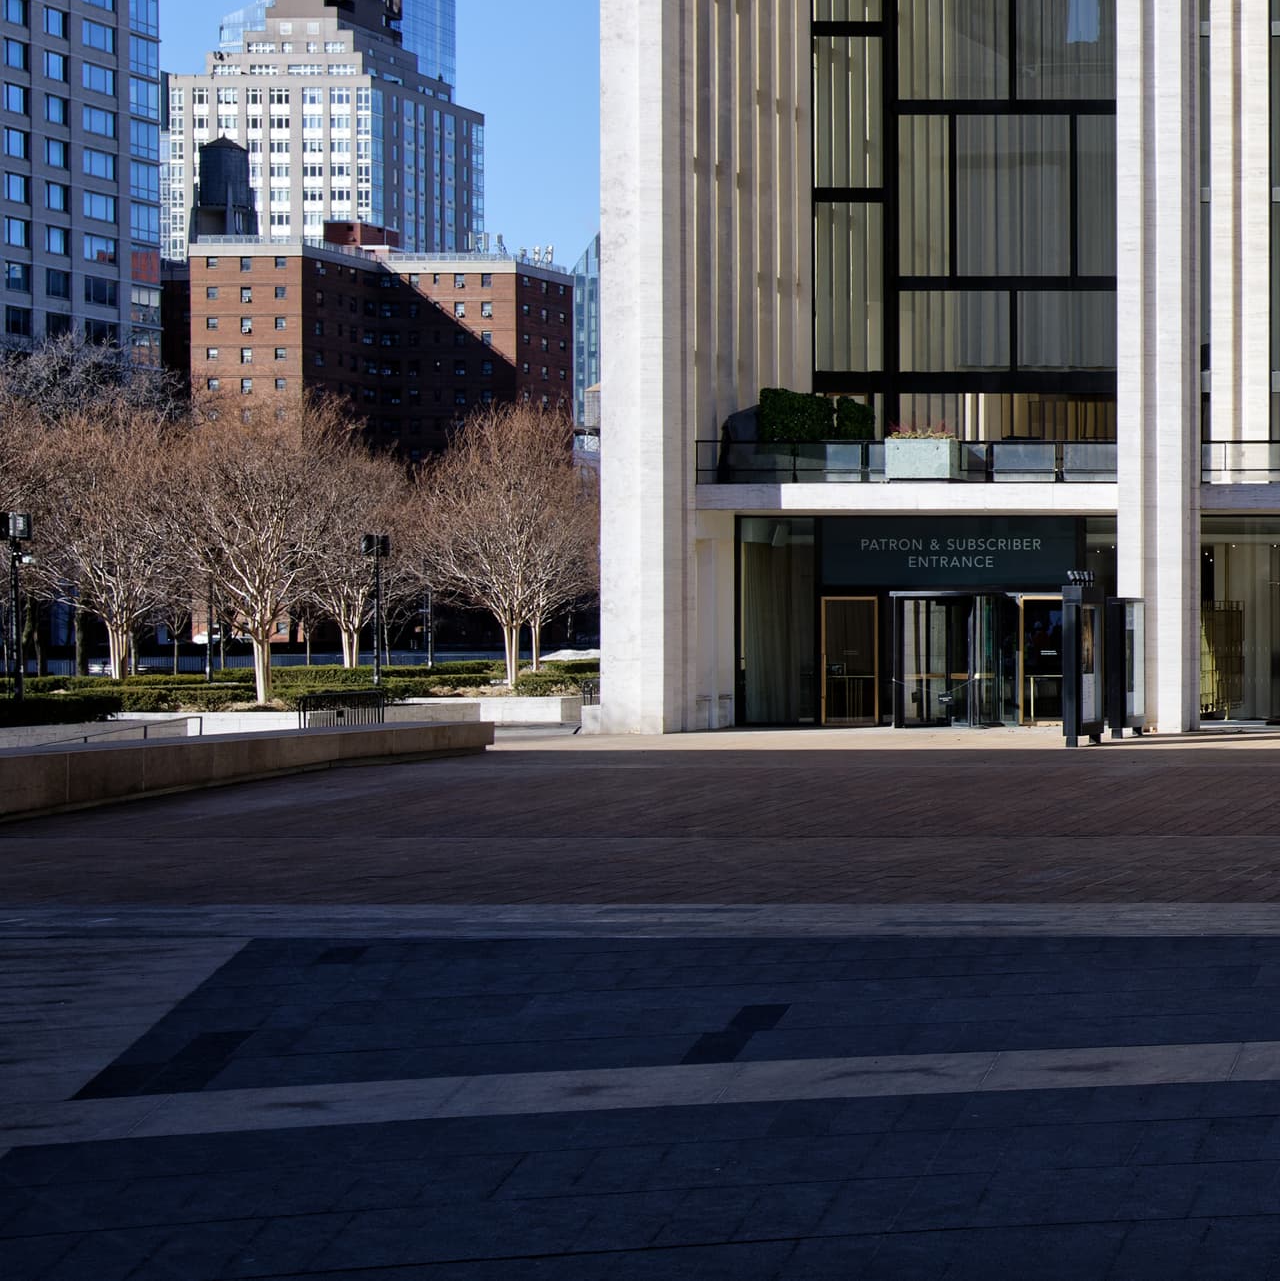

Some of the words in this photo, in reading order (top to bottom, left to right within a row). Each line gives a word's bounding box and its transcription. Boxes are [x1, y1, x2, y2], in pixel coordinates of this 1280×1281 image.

[860, 538, 923, 551] PATRON
[929, 538, 940, 551] &
[946, 538, 1042, 551] SUBSCRIBER
[908, 555, 995, 568] ENTRANCE
